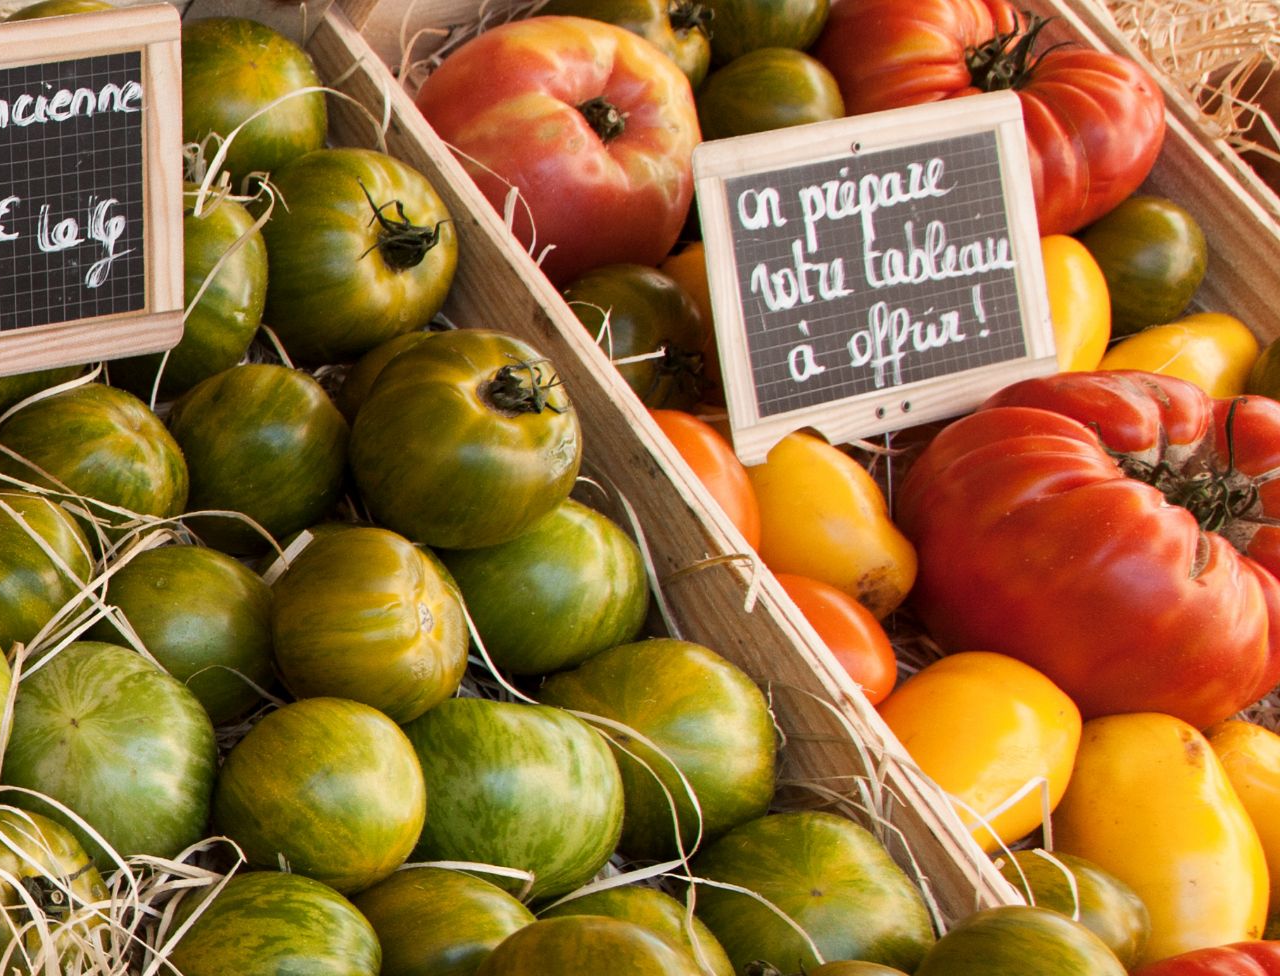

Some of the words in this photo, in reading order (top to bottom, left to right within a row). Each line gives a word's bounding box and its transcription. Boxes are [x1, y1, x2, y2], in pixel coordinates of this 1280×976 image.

[798, 157, 959, 253] prépare
[751, 239, 854, 312] votre
[863, 220, 1017, 289] tableau
[788, 320, 826, 382] à
